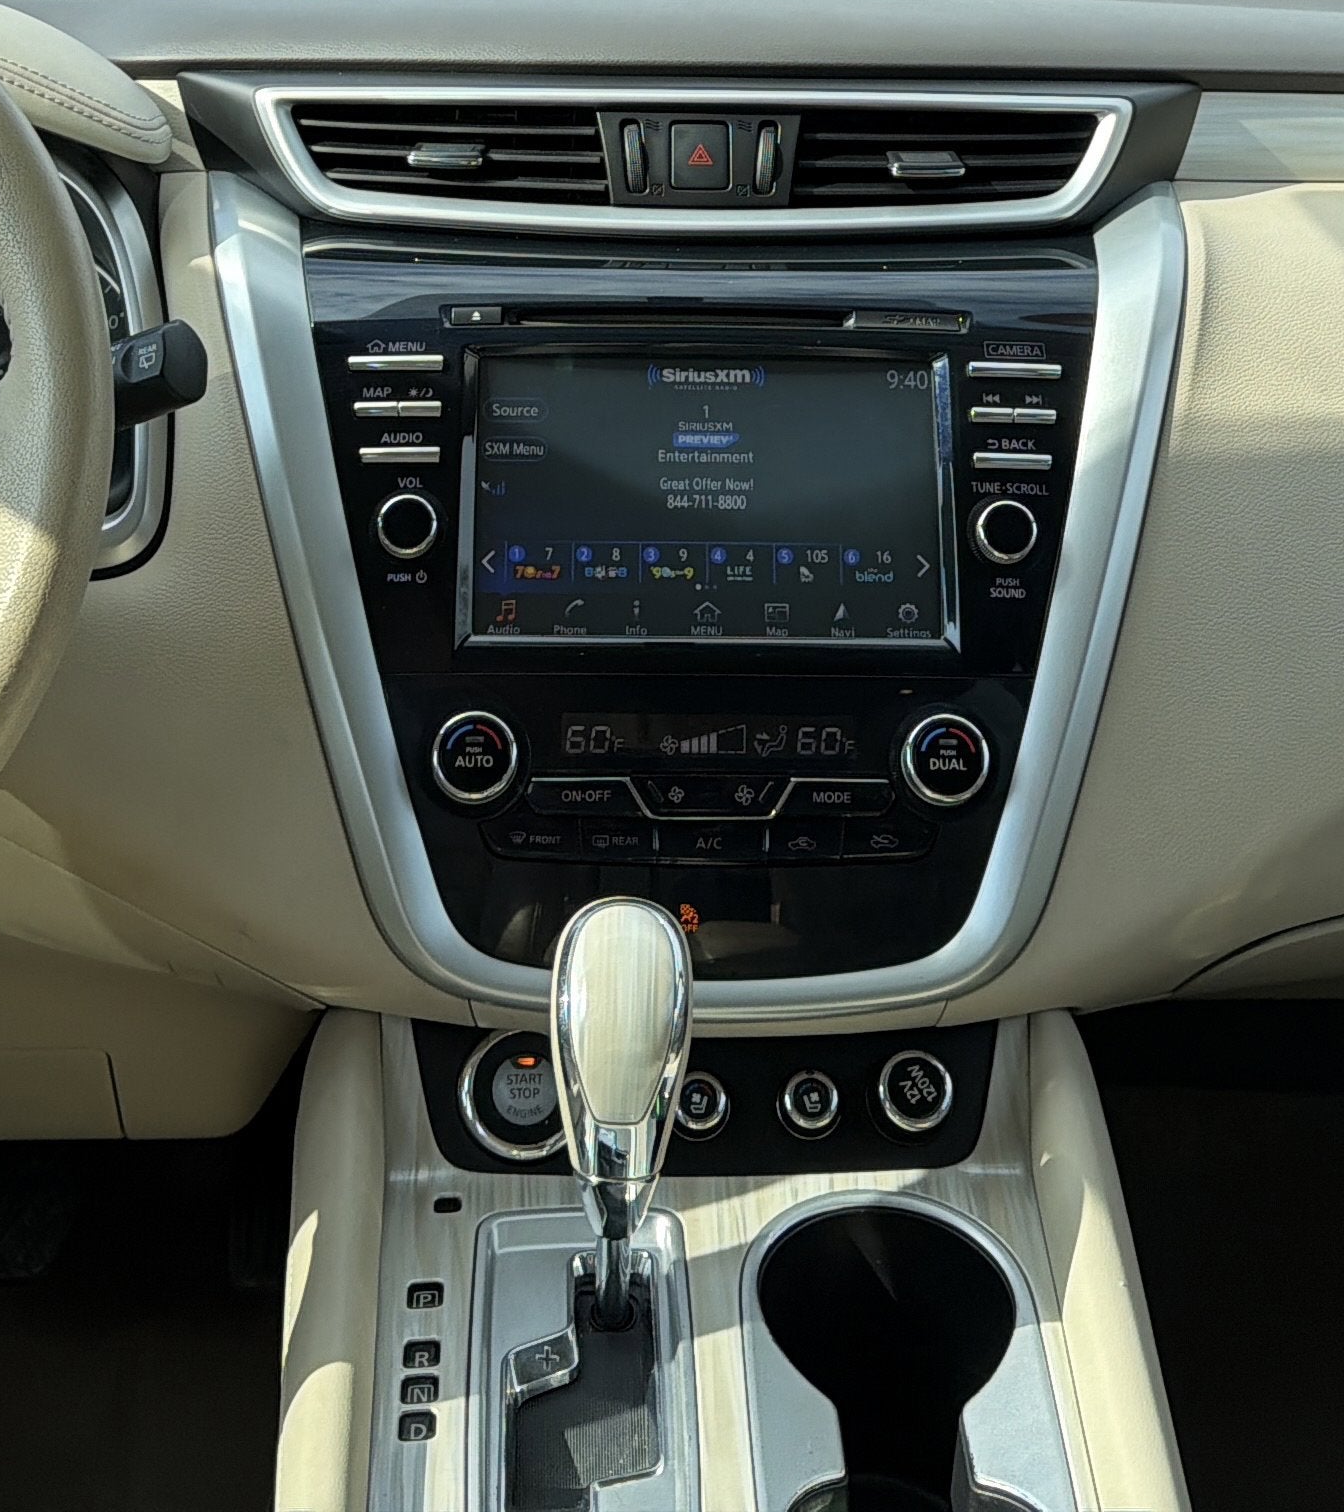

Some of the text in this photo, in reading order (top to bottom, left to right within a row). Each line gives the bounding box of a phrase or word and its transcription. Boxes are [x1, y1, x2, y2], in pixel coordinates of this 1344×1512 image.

[387, 341, 426, 353] MENU
[988, 344, 1042, 358] CAMERA
[886, 370, 929, 390] 9:40
[362, 387, 393, 398] MAP
[492, 403, 539, 417] Source
[678, 421, 733, 432] SIRIUSXM
[380, 432, 423, 444] AUDIO
[1001, 438, 1036, 451] BACK
[485, 441, 545, 456] SXM Menu
[657, 449, 755, 464] Entertainment
[397, 476, 424, 489] VOL
[659, 477, 755, 491] Great Offer Now!
[666, 494, 747, 510] 844-711-8800
[544, 547, 554, 561] 7
[611, 547, 622, 561] 8
[678, 548, 689, 562] 9
[745, 549, 755, 563] 4
[805, 549, 830, 564] 105
[875, 550, 893, 564] 16
[386, 572, 412, 583] PUSH
[726, 566, 754, 576] LIFE
[855, 571, 896, 583] blend
[995, 577, 1020, 588] PUSH
[989, 586, 1027, 600] SOUND
[487, 624, 521, 636] Audio
[553, 624, 588, 636] Phone
[625, 624, 648, 636] Info
[690, 626, 723, 637] MENU
[765, 626, 789, 638] Map
[830, 626, 856, 638] Navi
[454, 755, 494, 768] AUTO
[928, 757, 968, 771] DUAL
[812, 791, 853, 804] MODE
[529, 835, 562, 845] FRONT
[611, 835, 640, 846] REAR
[695, 837, 723, 850] A/C
[506, 1073, 544, 1086] START
[509, 1087, 541, 1099] STOP
[506, 1104, 544, 1119] ENGINE
[419, 1294, 433, 1308] P
[414, 1351, 430, 1368] R
[413, 1387, 428, 1403] N
[409, 1423, 427, 1440] D
